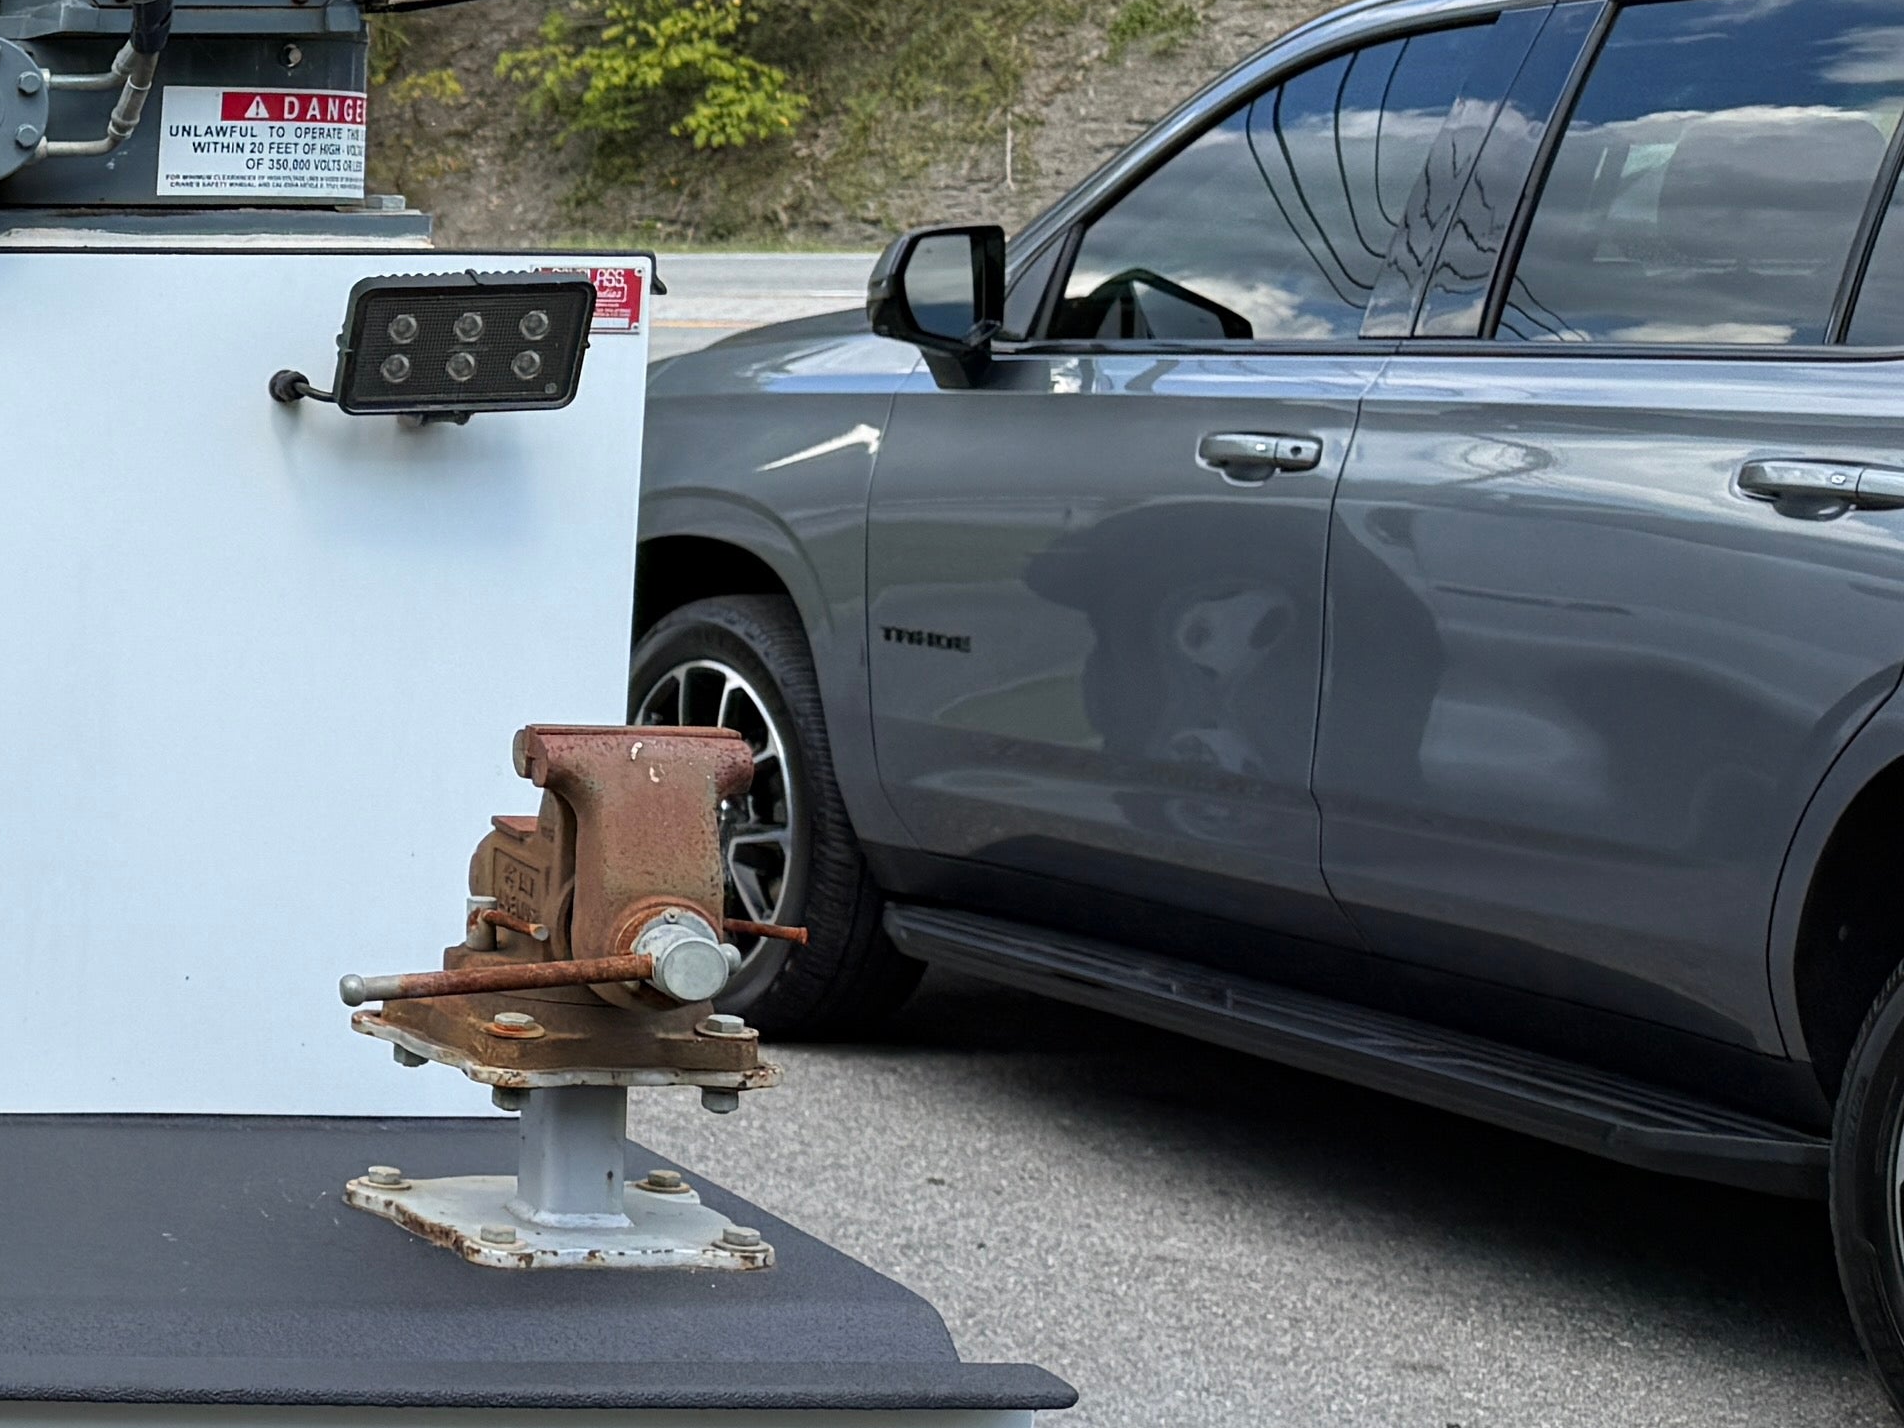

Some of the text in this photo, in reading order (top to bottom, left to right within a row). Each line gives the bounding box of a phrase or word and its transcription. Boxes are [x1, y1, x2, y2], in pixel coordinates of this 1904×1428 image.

[169, 124, 258, 139] UNLAWFUL
[268, 125, 286, 139] TO
[294, 126, 343, 140] OPERATE
[192, 141, 245, 154] WITHIN
[249, 142, 265, 155] 20
[268, 142, 300, 155] FEET
[302, 143, 318, 156] OF
[245, 157, 265, 171] OF
[268, 158, 311, 172] 350,000
[314, 158, 342, 172] VOLTS
